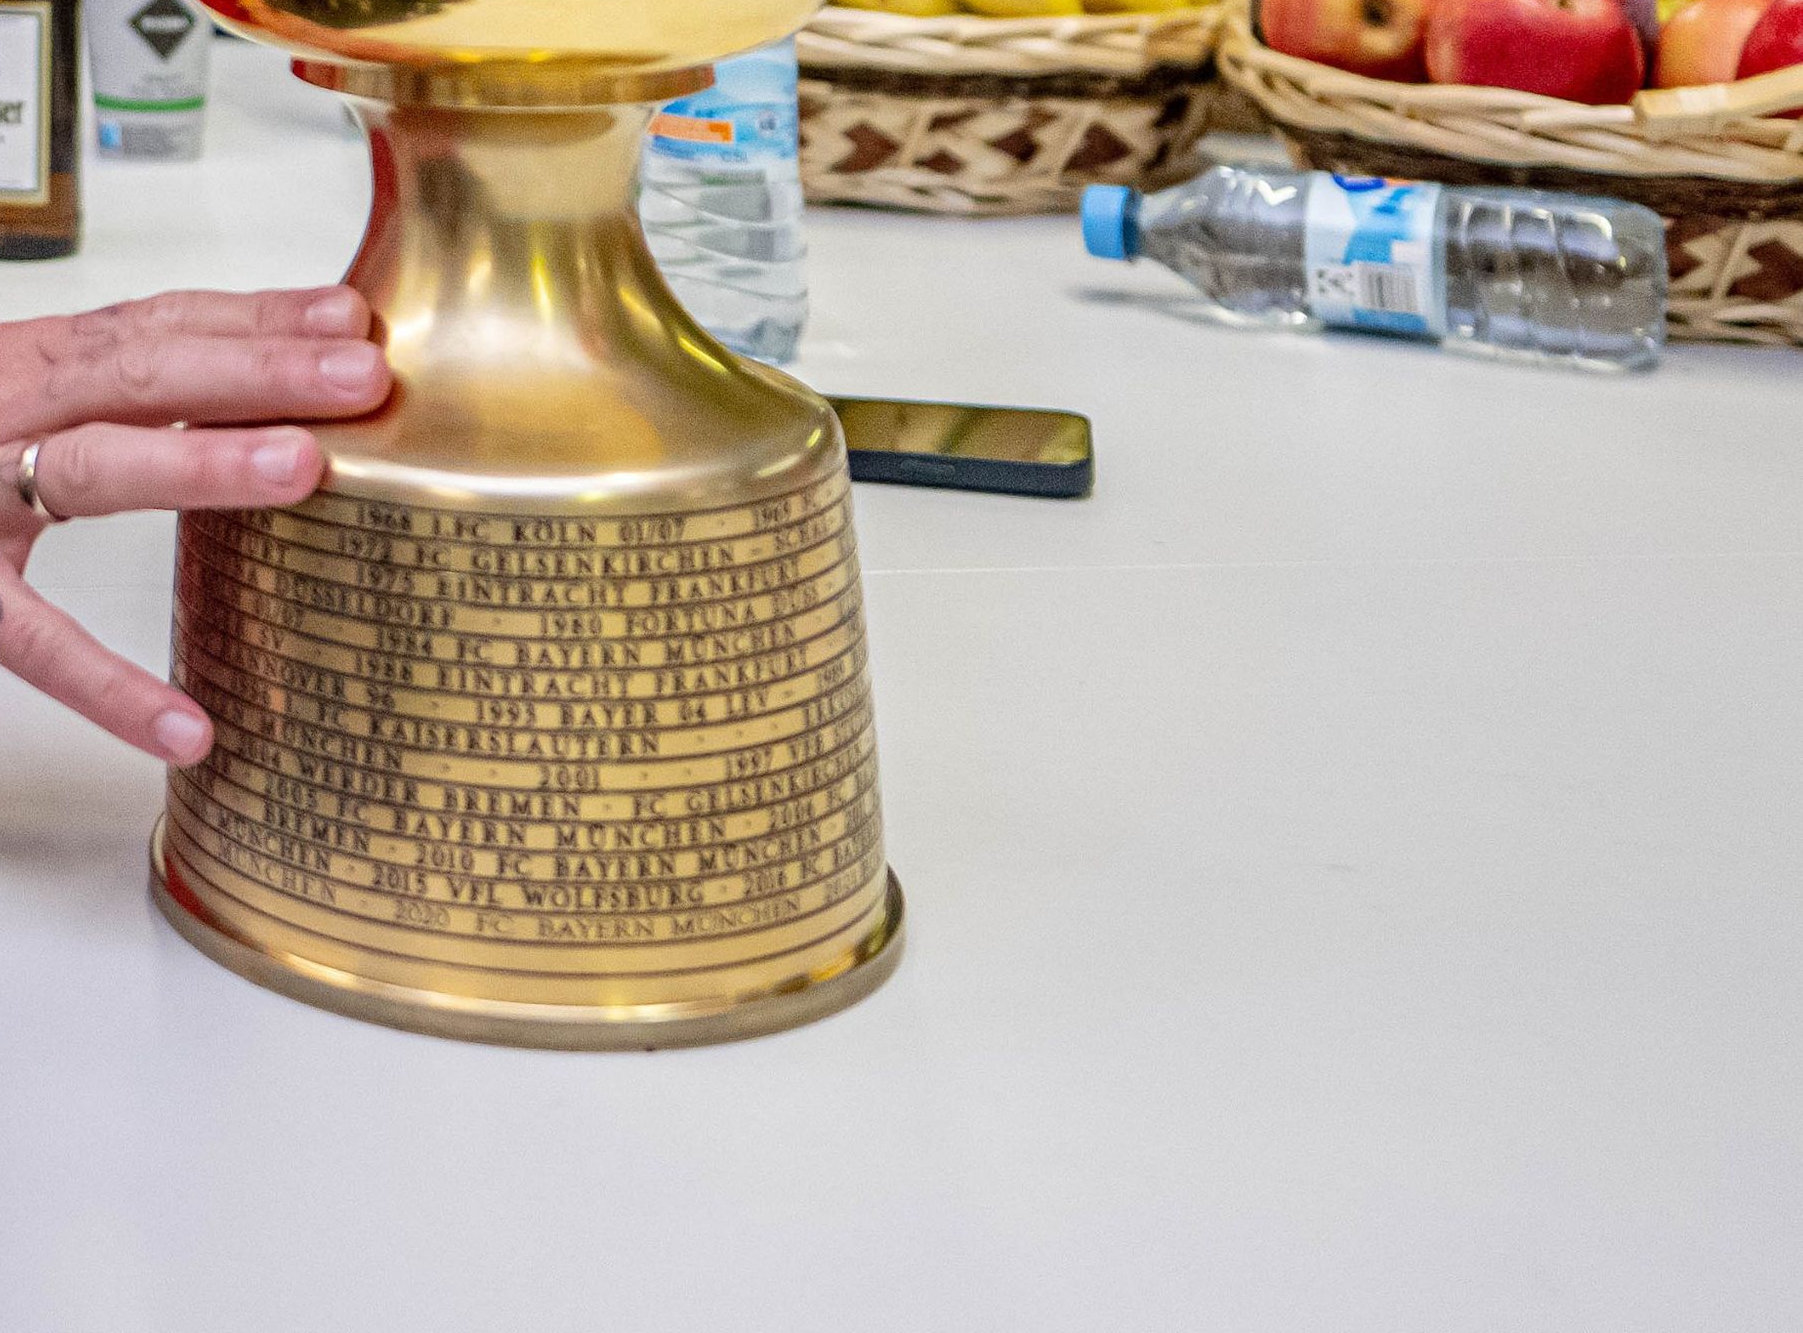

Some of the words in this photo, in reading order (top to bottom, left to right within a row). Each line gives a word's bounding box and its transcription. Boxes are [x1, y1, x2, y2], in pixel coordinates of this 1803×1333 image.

[512, 520, 595, 545] KÖLN
[438, 572, 624, 606] EINTRACHT
[651, 556, 799, 604] FRANKFURT
[470, 541, 733, 575] GELSENKIRCHEN
[625, 597, 755, 636] FORTUNA
[457, 635, 493, 663] FC
[515, 640, 640, 667] BAYERN
[665, 618, 795, 664] MÜNCHEN
[438, 664, 628, 697] EINTRACHT
[655, 645, 808, 695] FRANKFURT
[370, 712, 658, 757] KAISERSLAUTERN
[560, 700, 657, 727] BAYER
[296, 753, 418, 805] WERDER
[443, 785, 579, 819] BREMEN
[633, 793, 666, 818] FC
[263, 799, 368, 855] BREMEN
[414, 840, 474, 872] 2010
[496, 850, 532, 878] FC
[553, 852, 674, 880] BAYERN
[697, 822, 821, 874] MÜNCHEN
[337, 793, 368, 825] FC
[392, 806, 524, 846] BAYERN
[555, 815, 724, 849] MÜNCHEN
[372, 861, 427, 896] 2015
[521, 879, 704, 910] WOLFSBURG
[477, 909, 513, 937] FC
[537, 914, 654, 940] BAYERN
